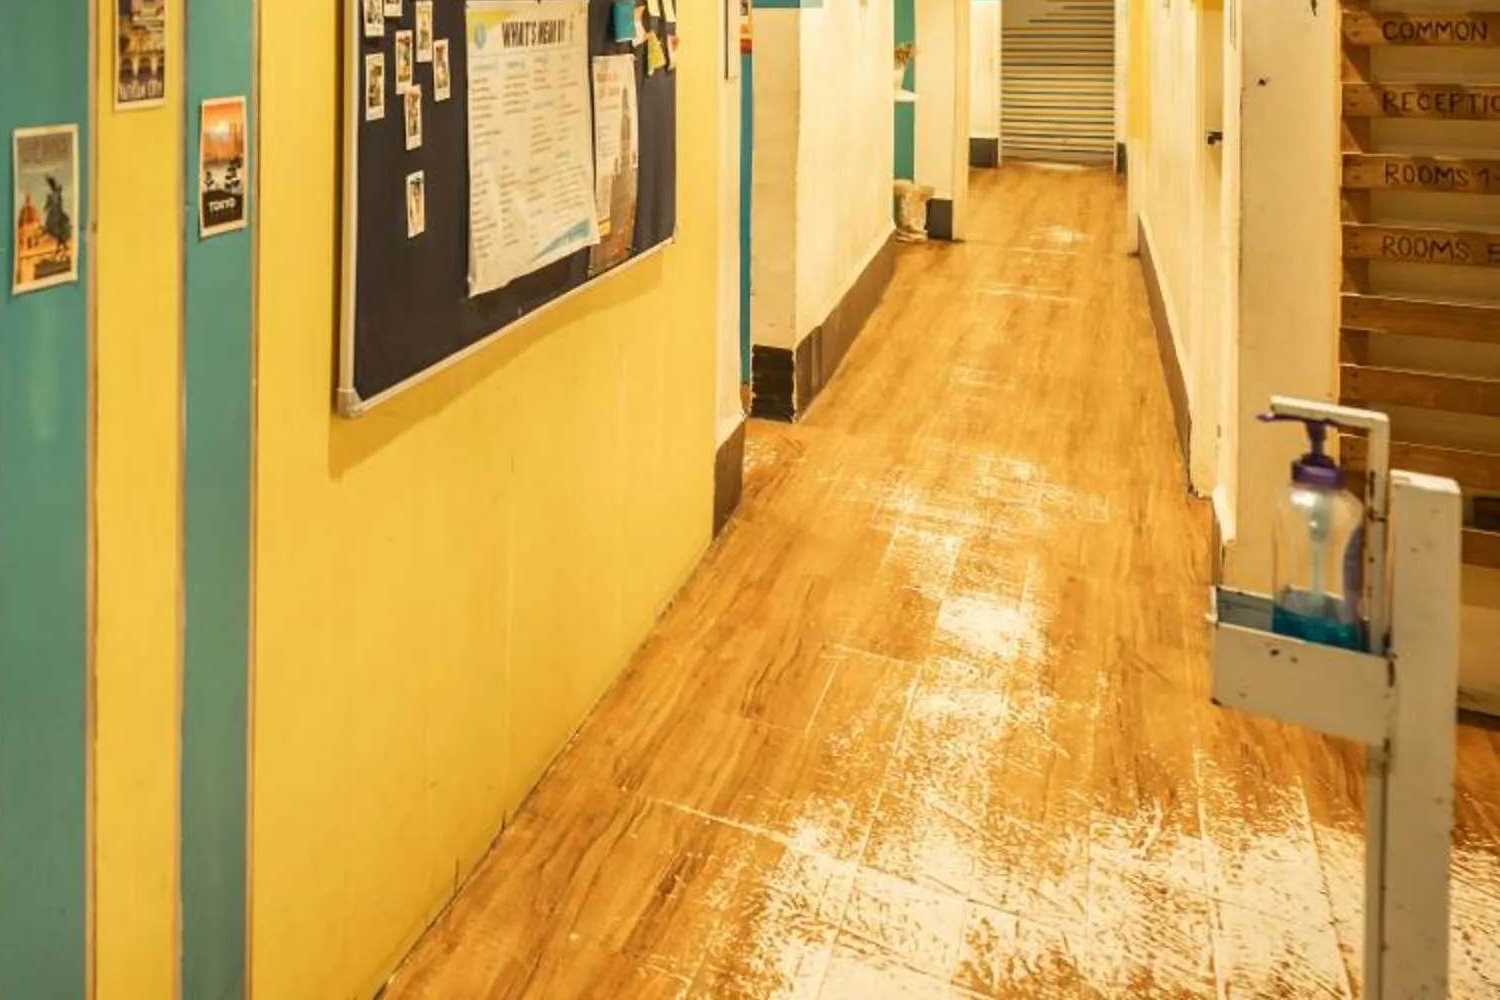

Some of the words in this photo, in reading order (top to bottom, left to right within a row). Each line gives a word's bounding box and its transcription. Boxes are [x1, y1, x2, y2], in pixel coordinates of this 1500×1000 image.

[1382, 20, 1488, 41] COMMON
[1385, 163, 1469, 187] ROOMS
[1381, 235, 1470, 261] ROOMS
